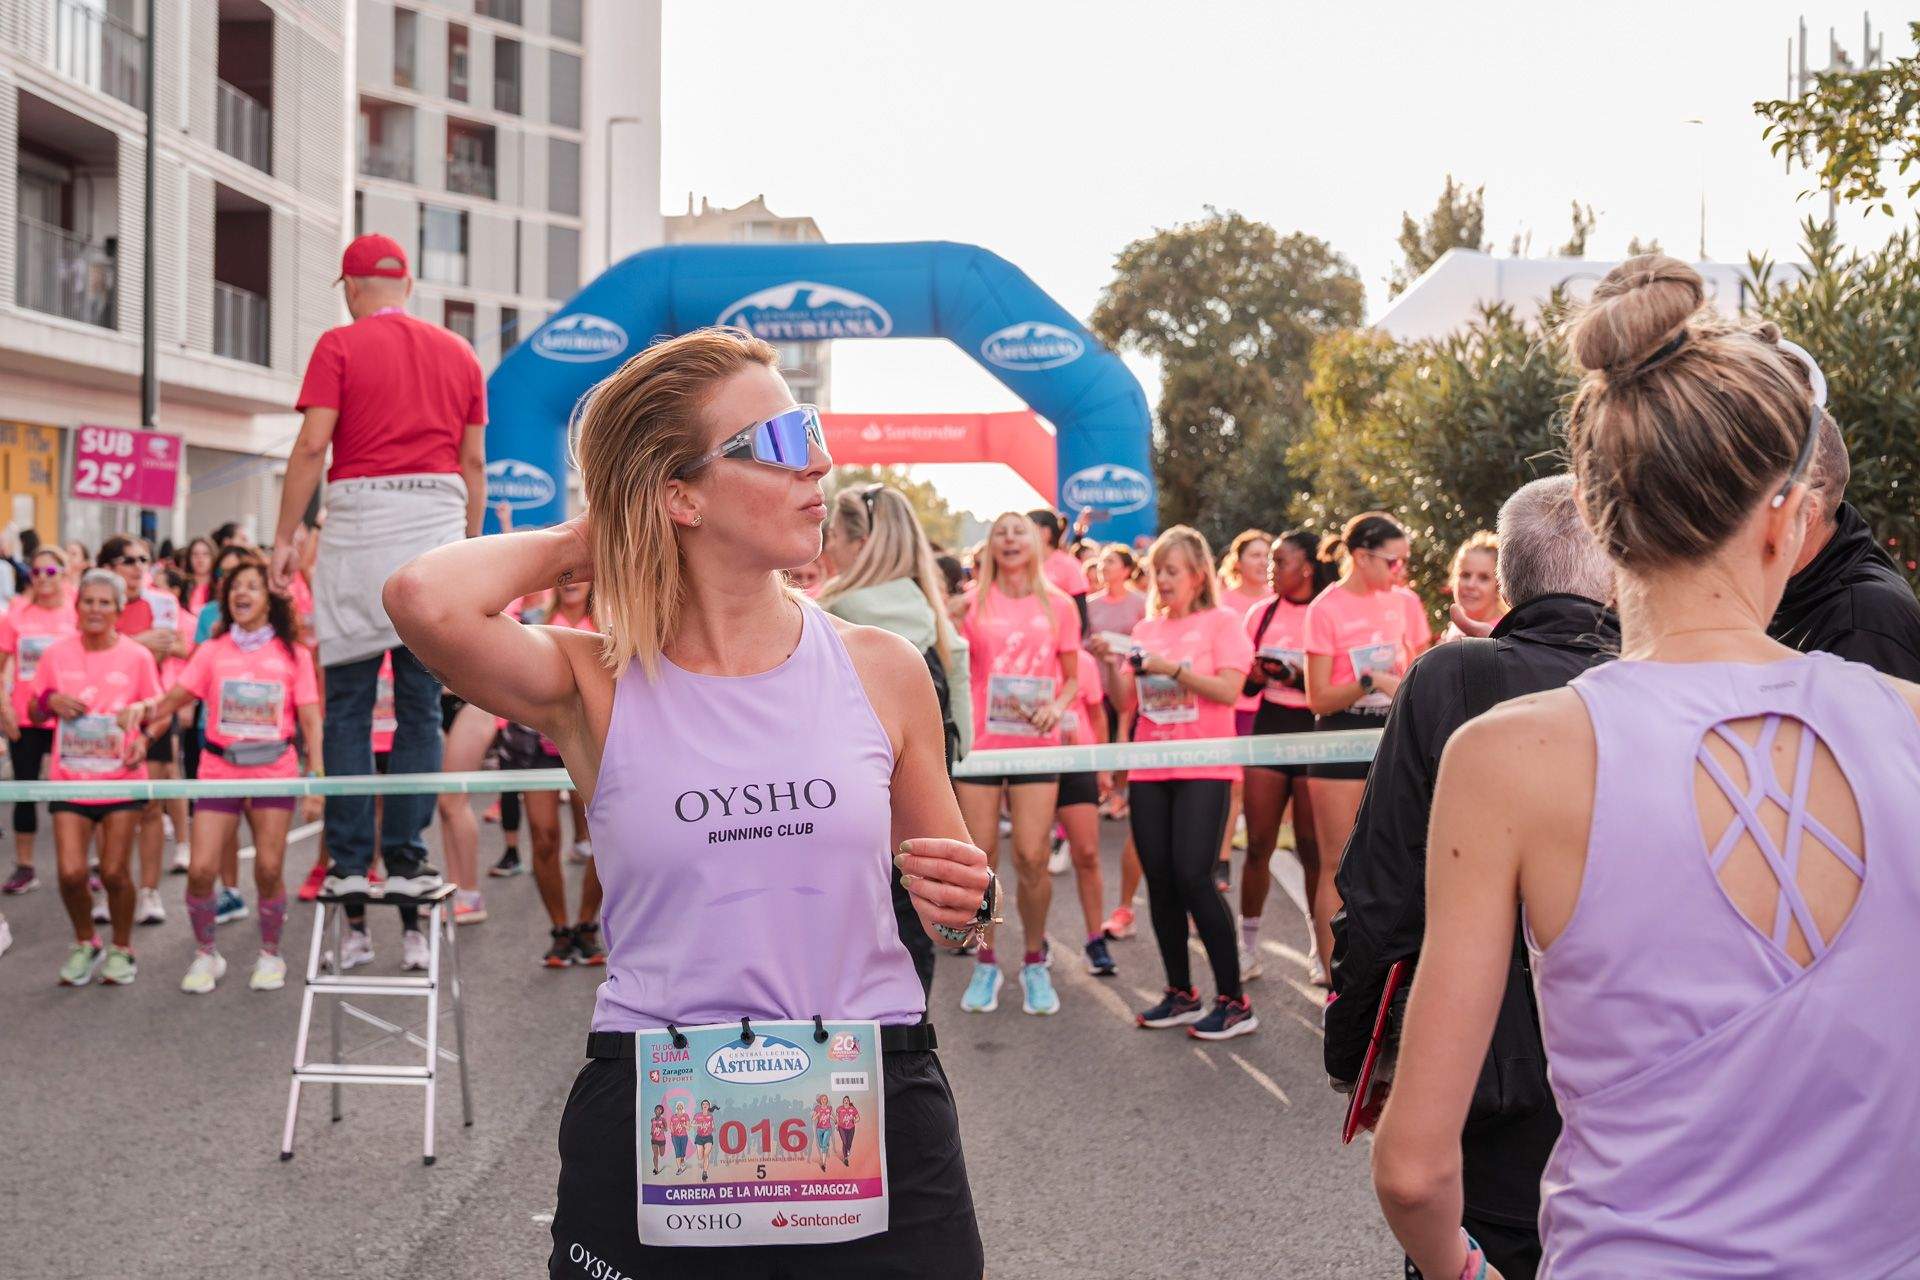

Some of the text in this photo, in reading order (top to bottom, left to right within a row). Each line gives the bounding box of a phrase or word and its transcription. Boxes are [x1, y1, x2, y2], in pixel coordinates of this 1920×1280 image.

[81, 428, 134, 457] SUB
[75, 459, 136, 496] 25'
[674, 778, 837, 823] OYSHO
[708, 822, 814, 844] RUNNING CLUB
[652, 1050, 690, 1064] SUMA
[713, 1055, 804, 1074] ASTURIANA
[662, 1067, 694, 1076] Zaragoza
[719, 1117, 809, 1155] 016
[756, 1164, 767, 1179] 5
[665, 1183, 860, 1200] CARRERA DE LA MUJER ZARAGOZA
[666, 1212, 742, 1230] OYSHO
[791, 1212, 862, 1227] Santander
[569, 1243, 634, 1280] OYSH
